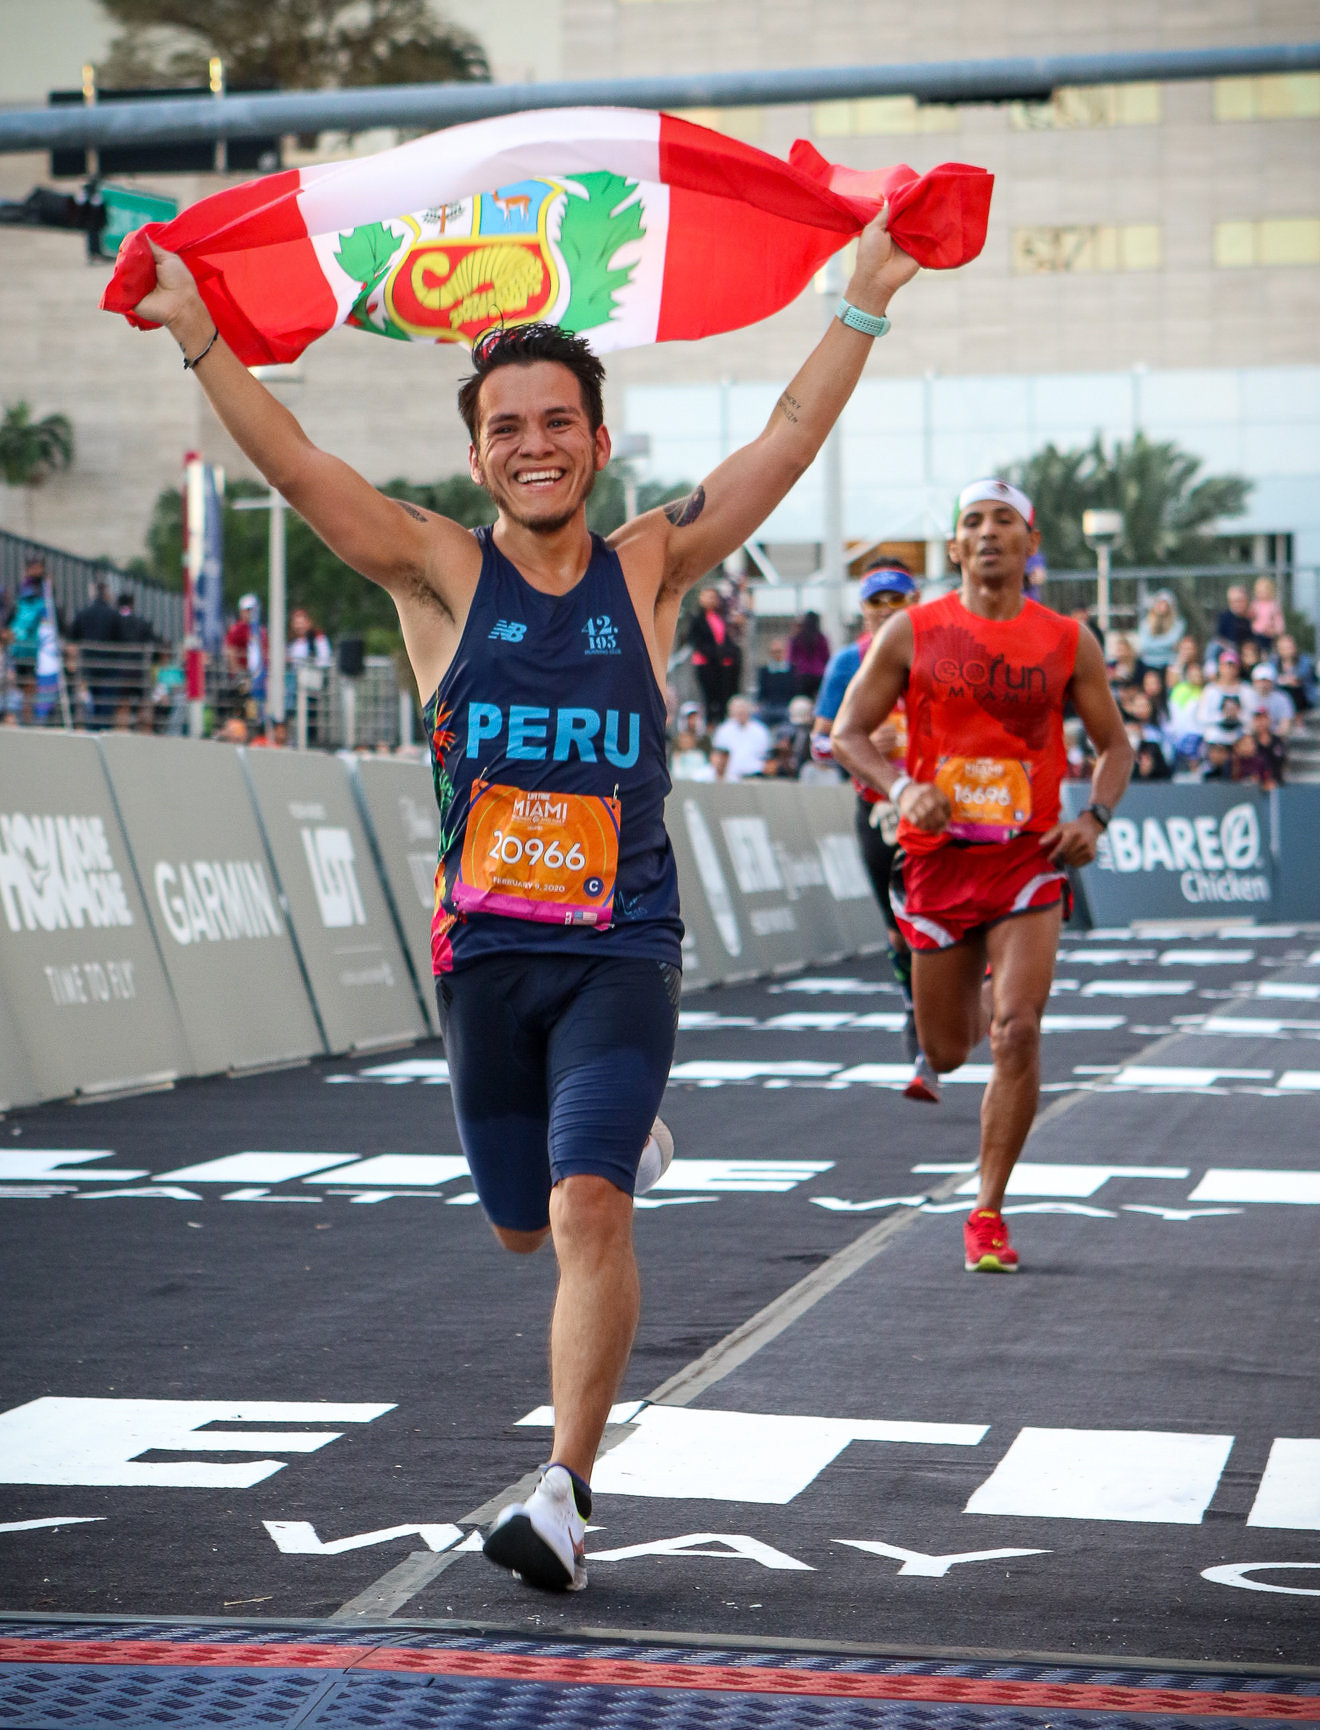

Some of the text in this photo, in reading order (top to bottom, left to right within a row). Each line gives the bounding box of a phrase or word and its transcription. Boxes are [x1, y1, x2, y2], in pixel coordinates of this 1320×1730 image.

[466, 702, 641, 769] PERU
[512, 798, 568, 825] MIAMI
[953, 783, 1012, 807] 16696
[488, 830, 586, 872] 20966
[1107, 815, 1226, 873] BARE
[153, 859, 283, 946] GARMIN
[1180, 869, 1272, 904] Chicken
